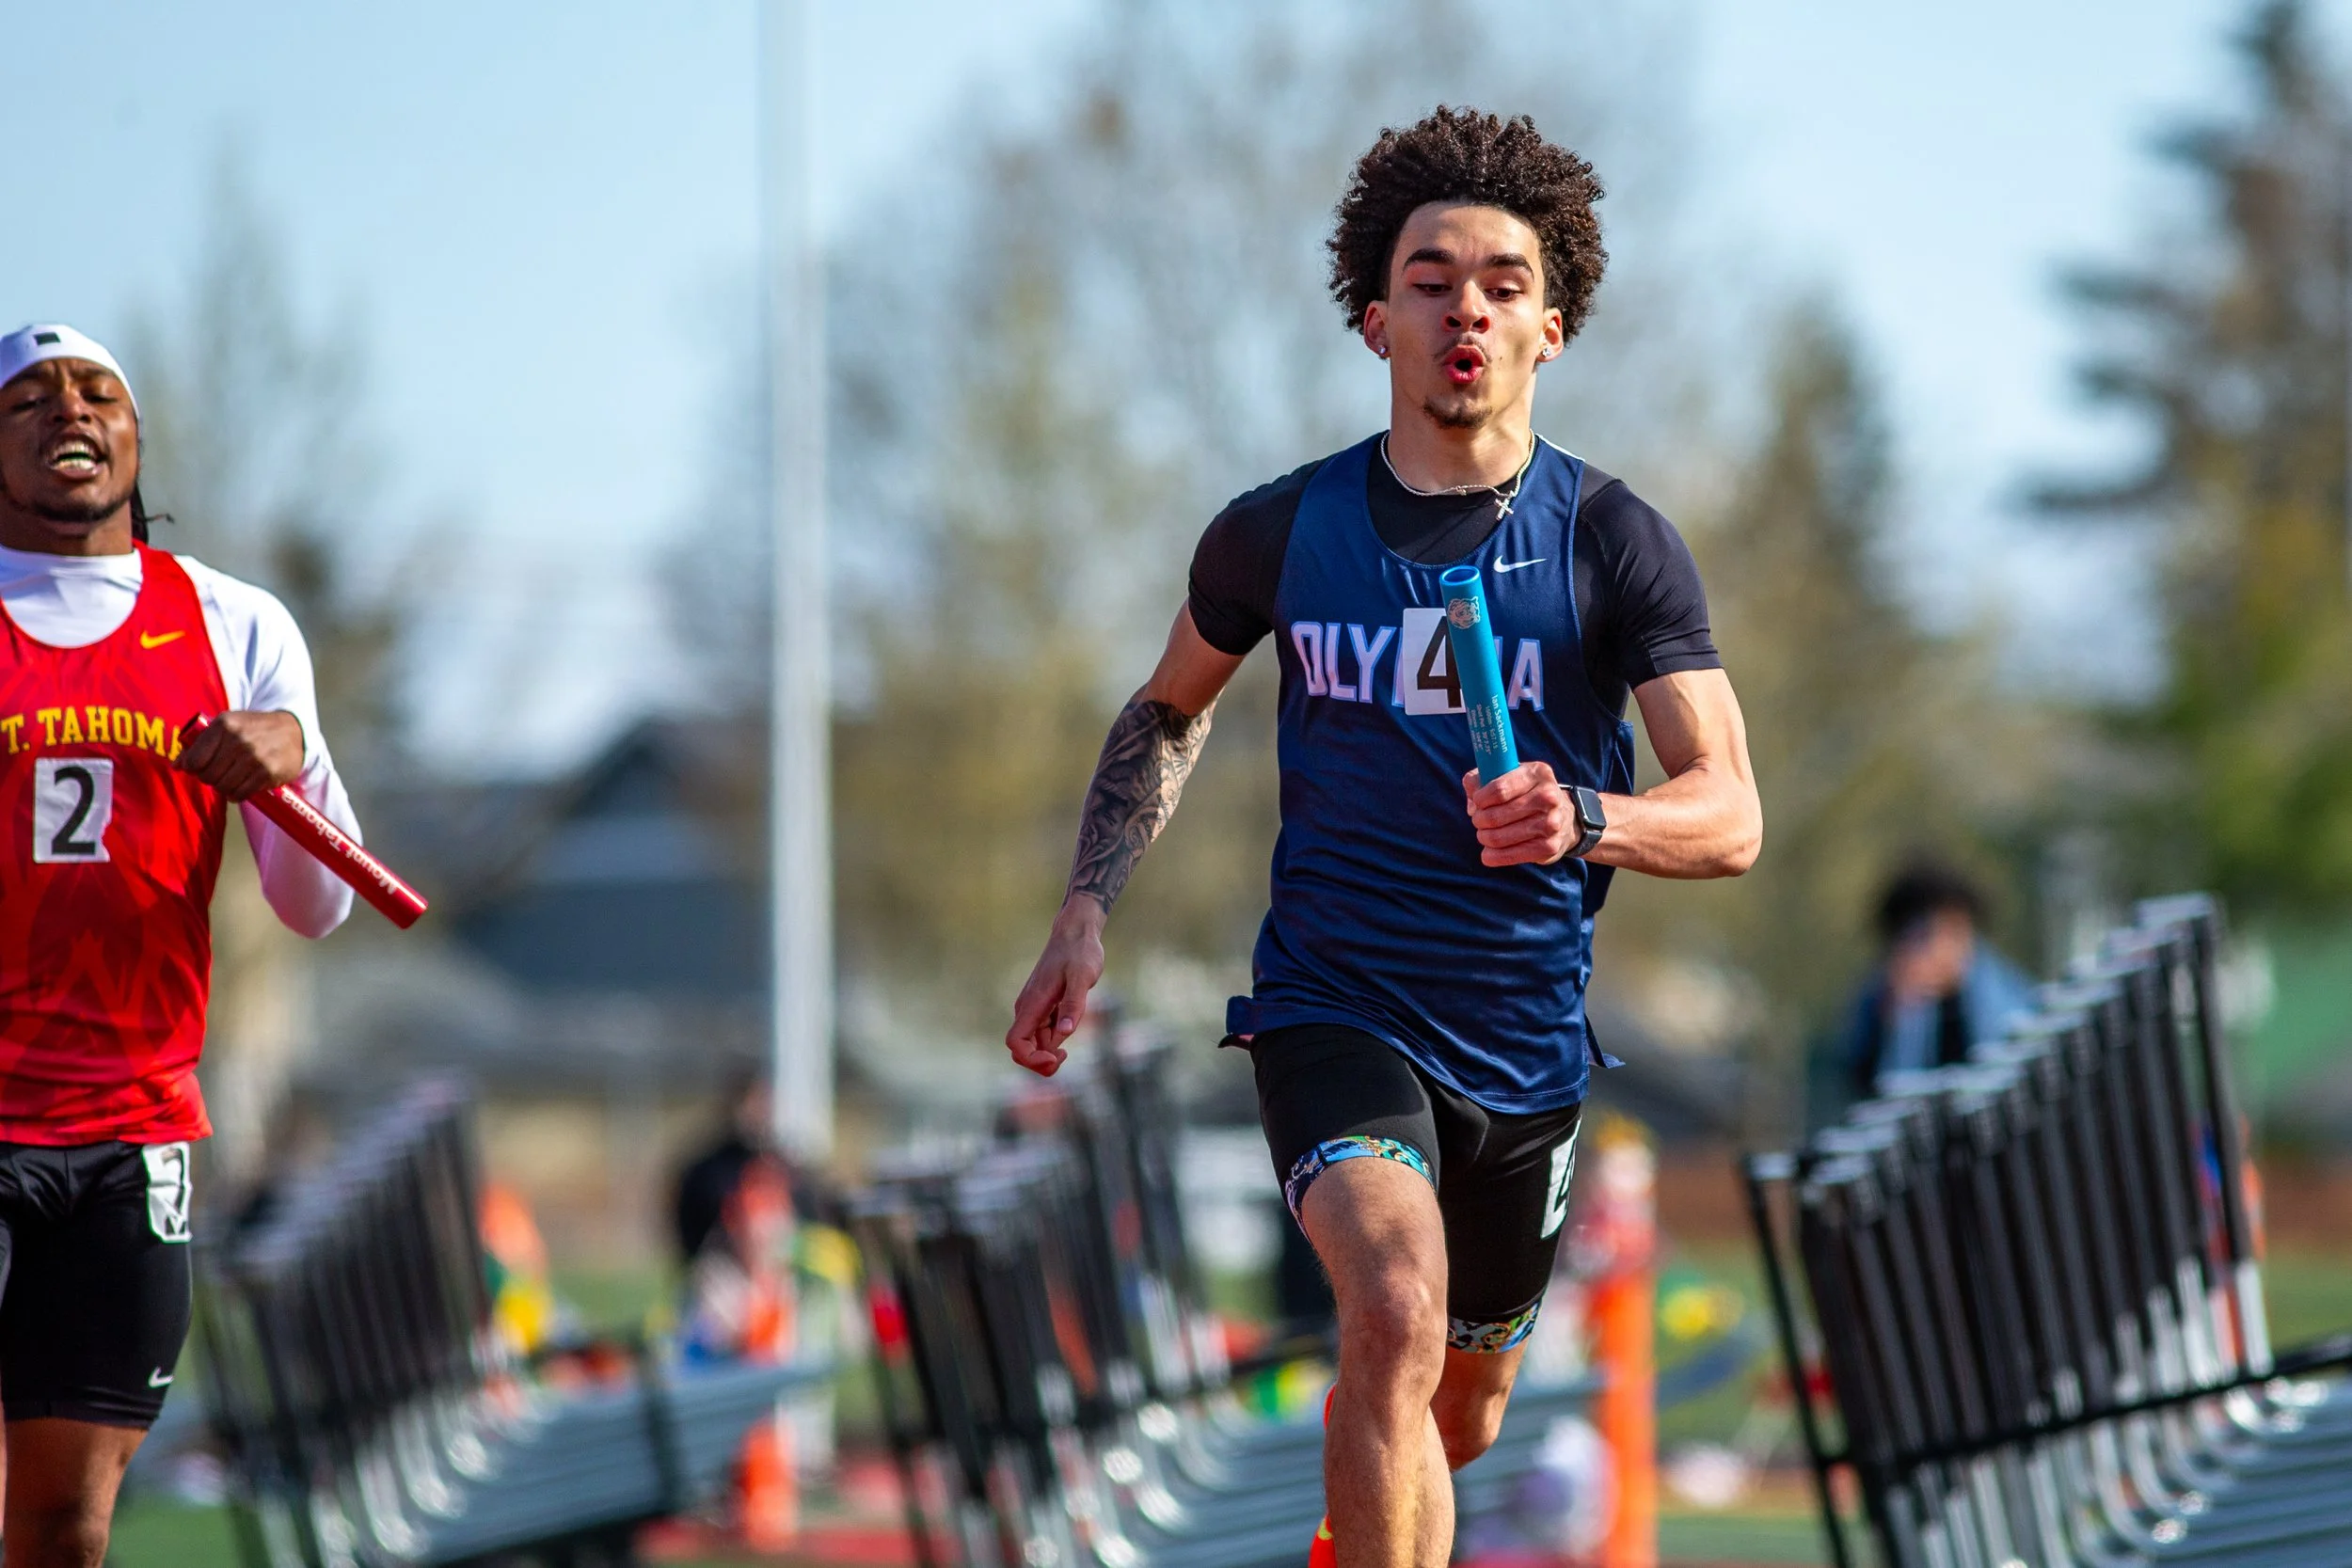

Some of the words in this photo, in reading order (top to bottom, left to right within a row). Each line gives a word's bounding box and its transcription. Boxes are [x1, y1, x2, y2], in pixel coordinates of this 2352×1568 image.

[1290, 621, 1545, 712] OLYA
[1416, 616, 1463, 709] 4
[1494, 708, 1508, 753] Sackmann
[51, 765, 97, 855] 2
[344, 845, 398, 895] Mount
